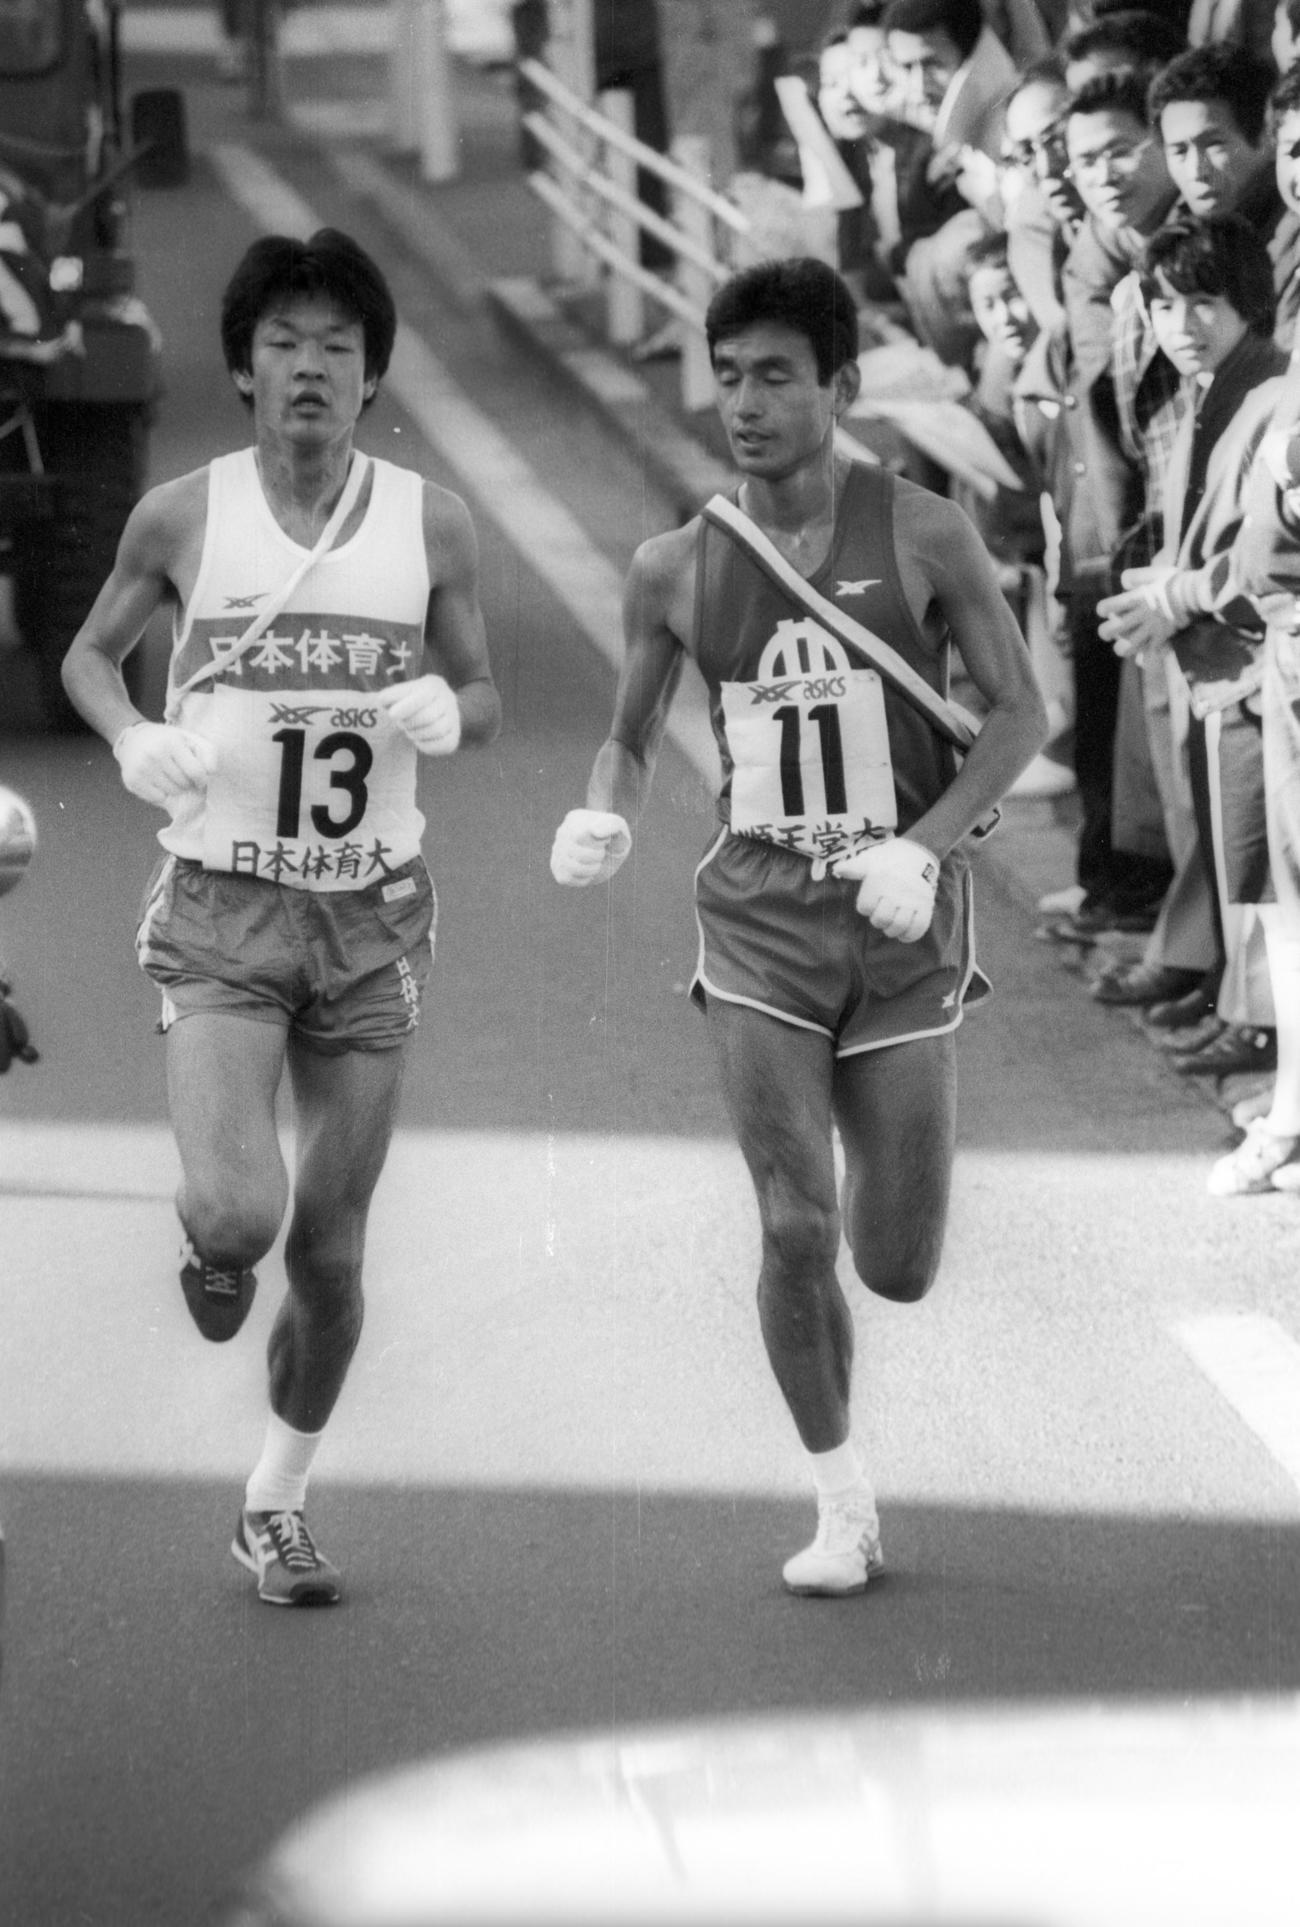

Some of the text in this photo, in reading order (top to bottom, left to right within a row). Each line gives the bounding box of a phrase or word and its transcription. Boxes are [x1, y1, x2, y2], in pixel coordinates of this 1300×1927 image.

[803, 676, 847, 700] asics
[330, 708, 378, 728] asics
[772, 703, 848, 816] 11
[272, 728, 373, 839] 13
[232, 838, 393, 881] 日本体育大
